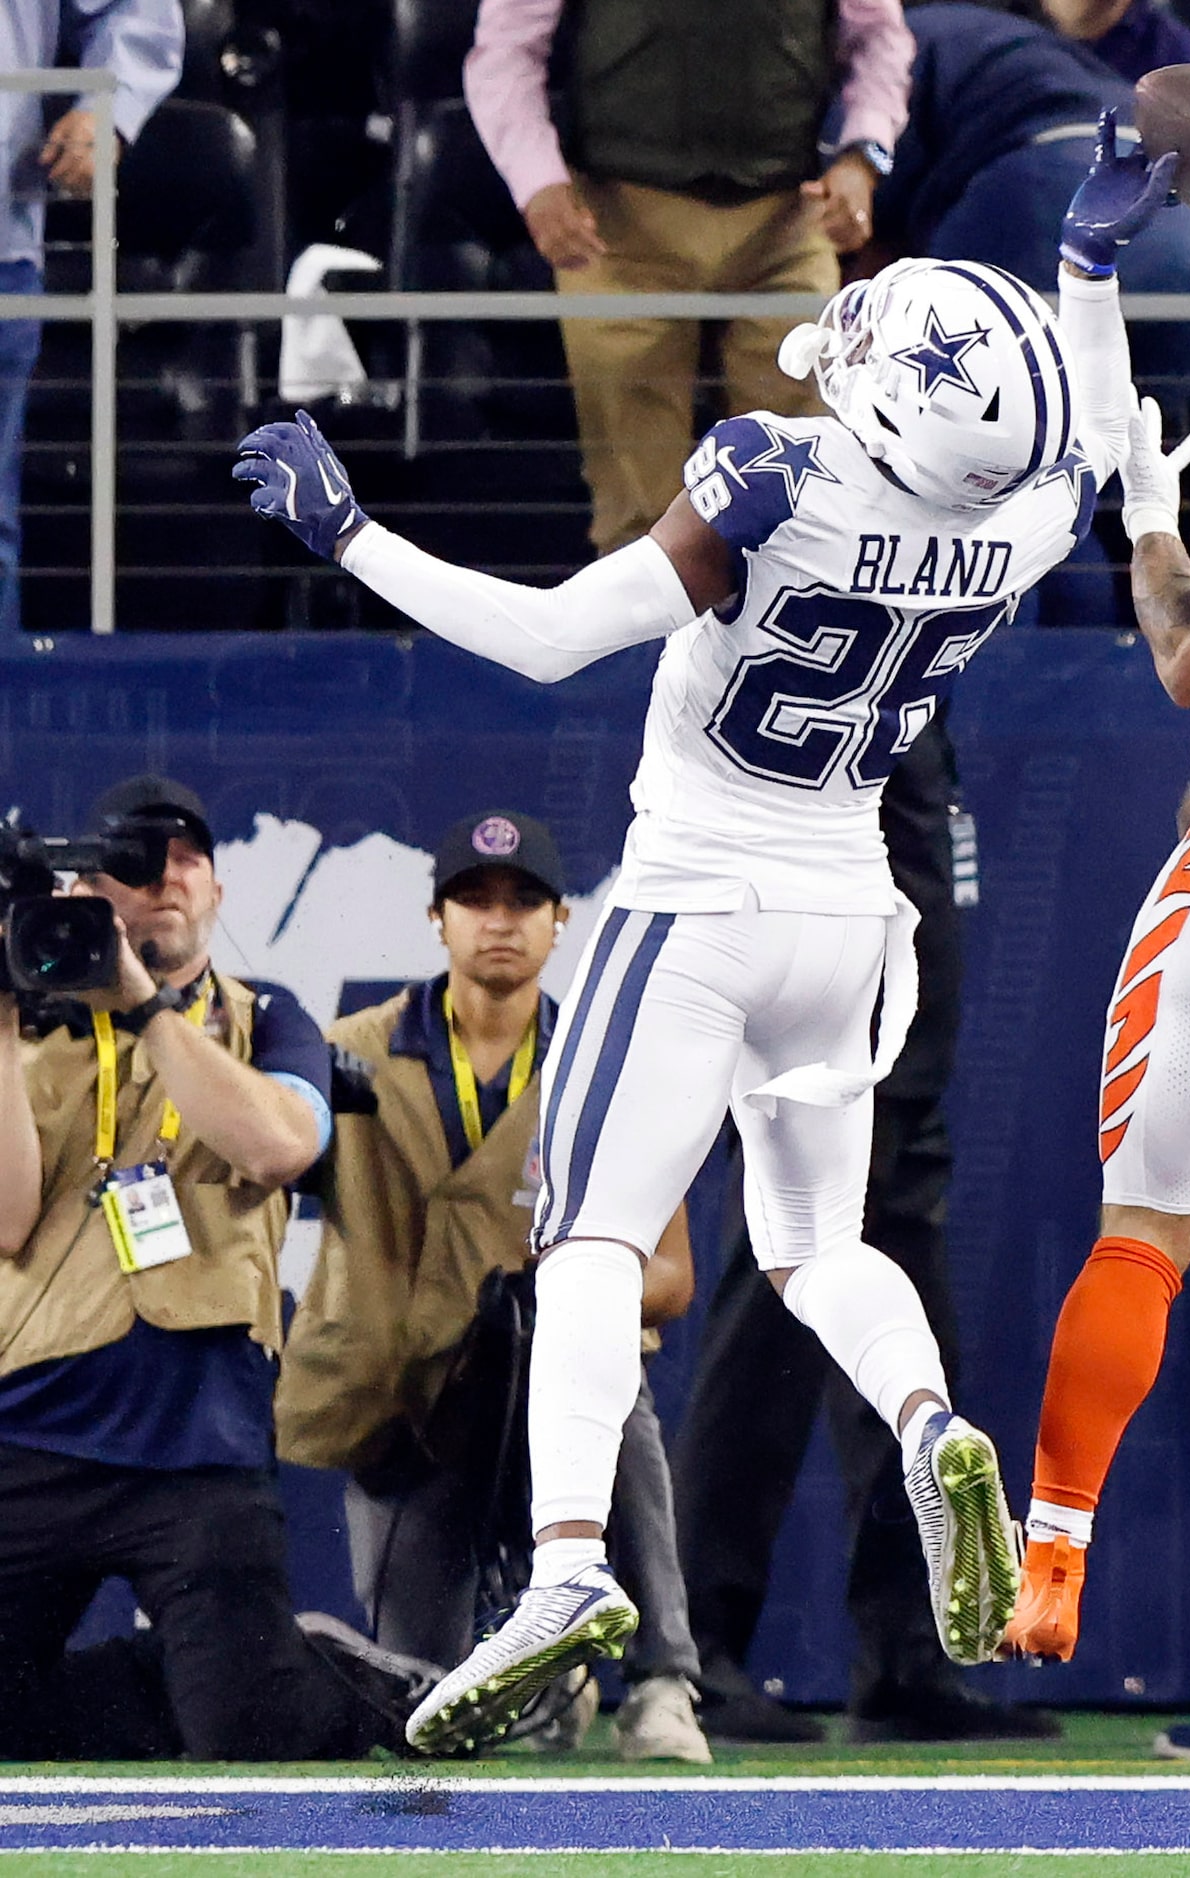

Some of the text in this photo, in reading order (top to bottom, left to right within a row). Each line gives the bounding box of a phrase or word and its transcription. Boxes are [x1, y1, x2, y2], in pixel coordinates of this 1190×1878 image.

[684, 436, 733, 523] 26
[850, 533, 1013, 598] BLAND
[704, 582, 1010, 791] 26
